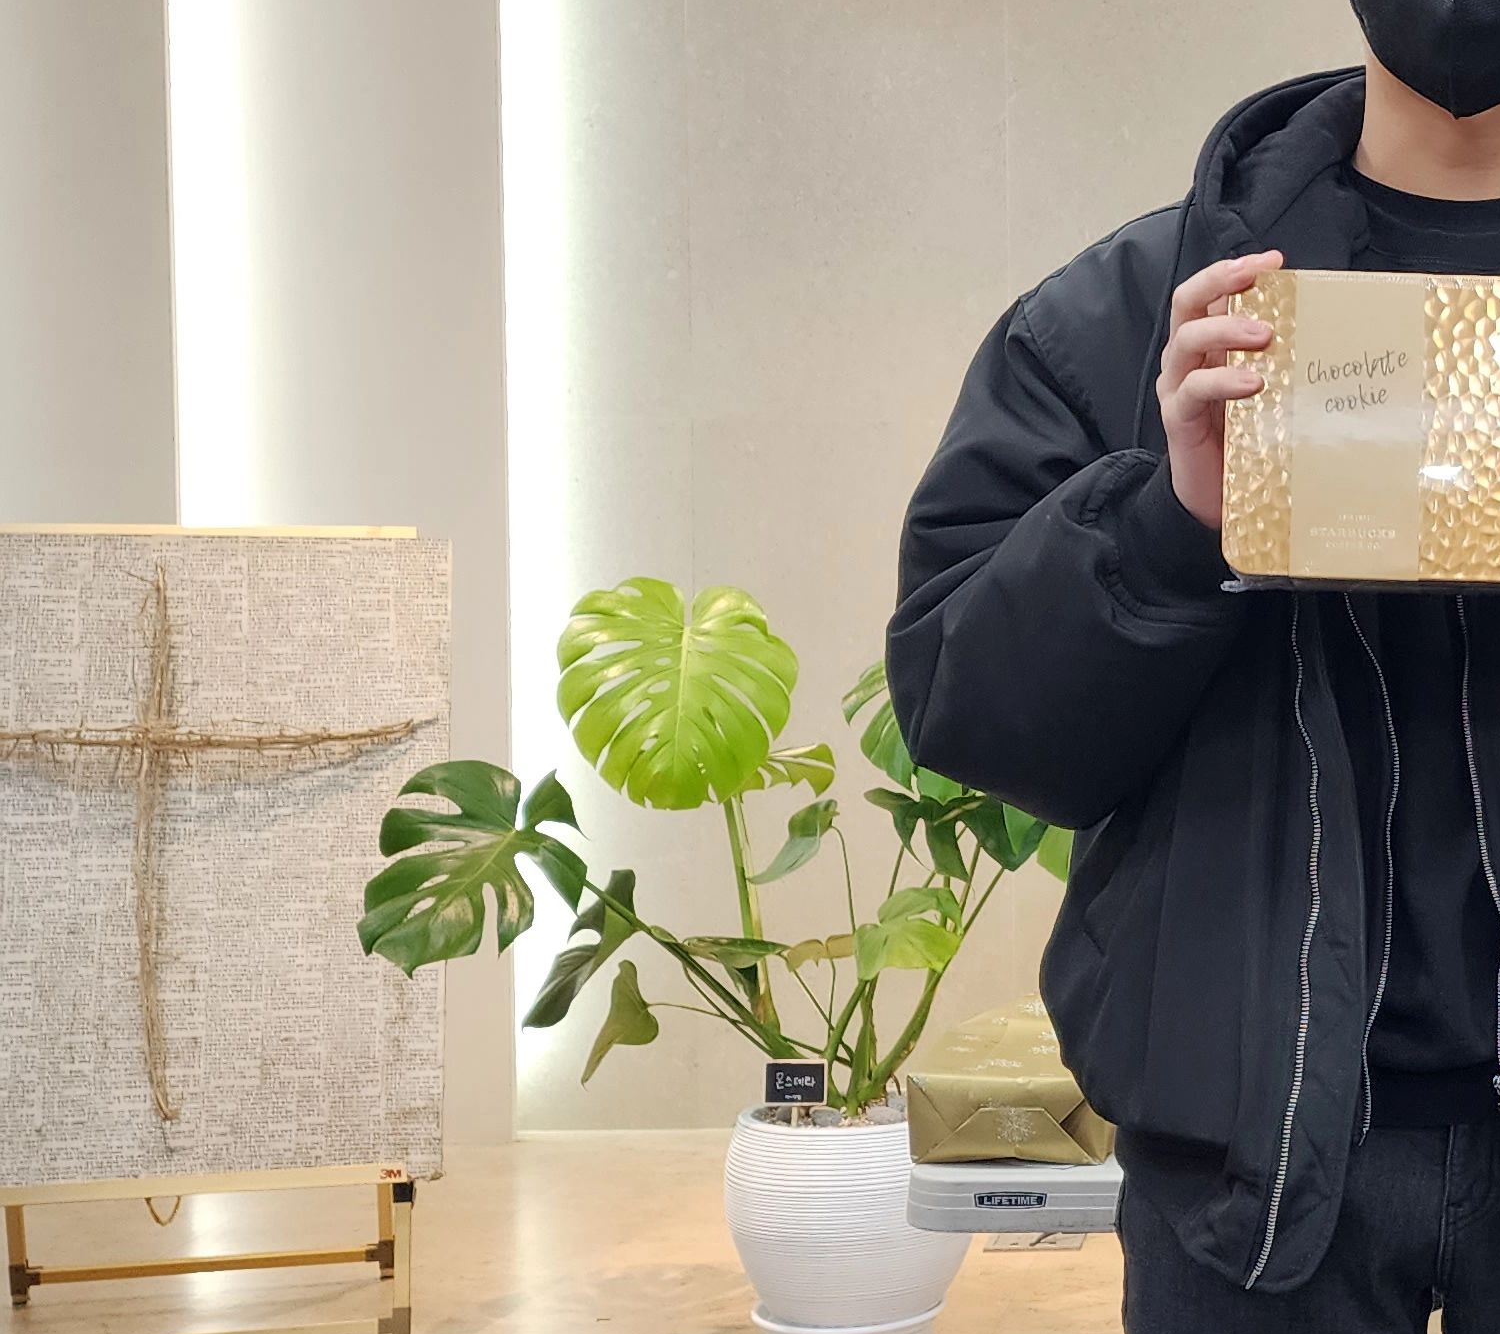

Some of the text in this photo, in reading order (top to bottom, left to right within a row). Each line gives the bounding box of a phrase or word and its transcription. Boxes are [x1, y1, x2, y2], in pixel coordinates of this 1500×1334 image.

[1307, 350, 1408, 384] Chocolate
[1325, 383, 1389, 412] cookie
[380, 1168, 402, 1180] 3M
[983, 1196, 1039, 1205] LIFETIME
